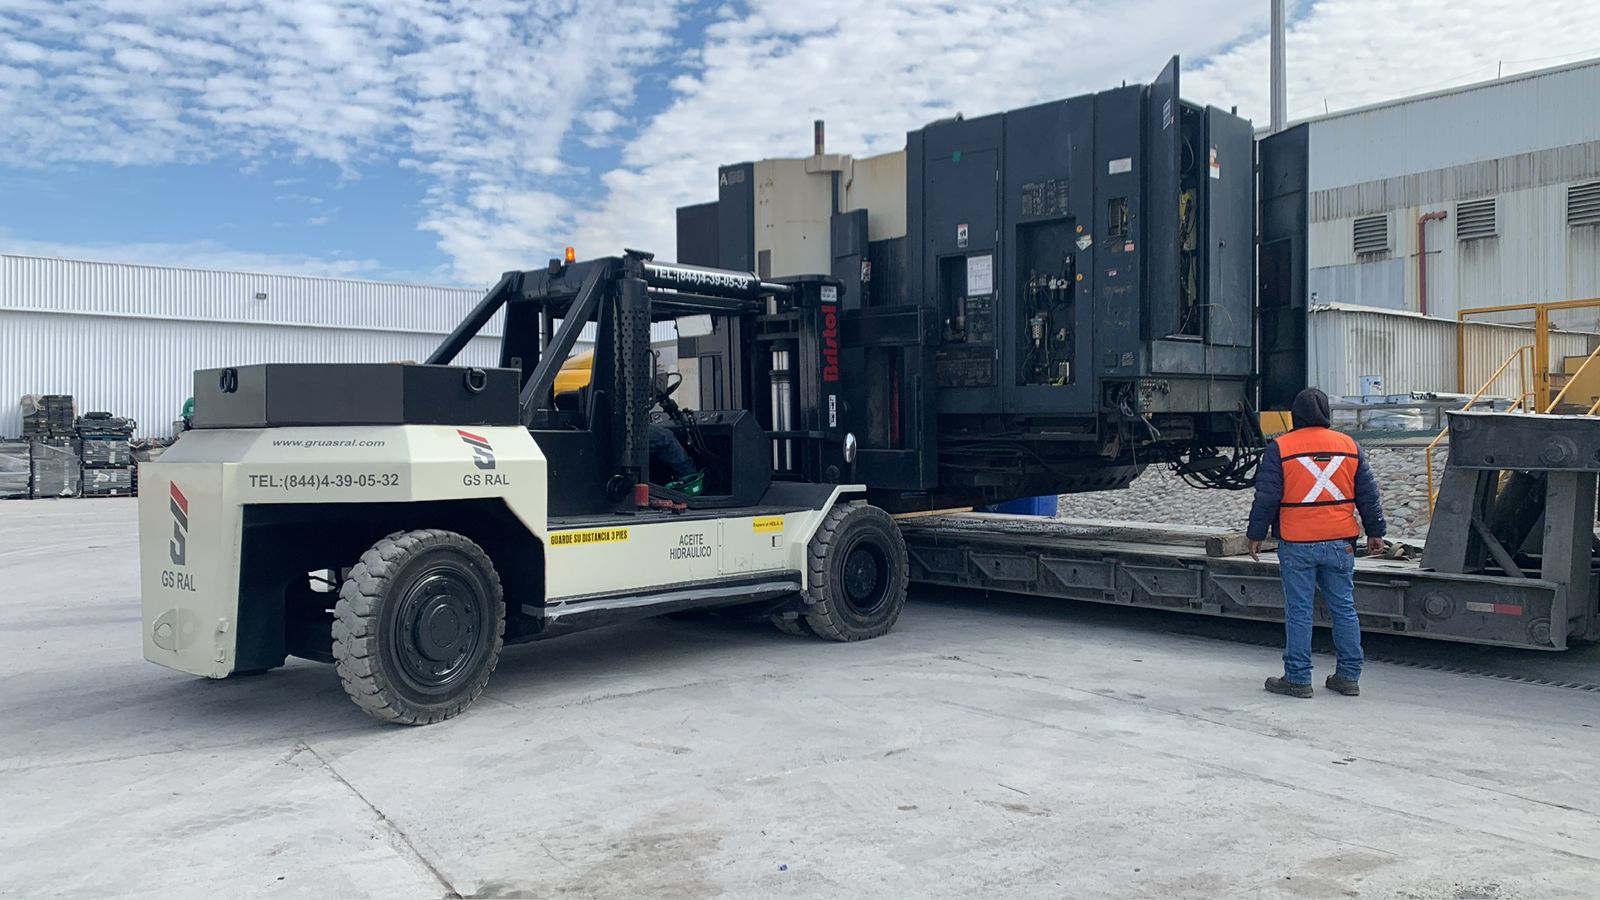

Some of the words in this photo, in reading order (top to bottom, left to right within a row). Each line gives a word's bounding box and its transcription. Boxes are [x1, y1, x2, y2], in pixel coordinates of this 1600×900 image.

[654, 266, 749, 290] TEL:(844)4-39-05-32
[821, 305, 839, 382] Bristol
[272, 439, 385, 448] www.gruasral.com
[249, 473, 399, 490] TEL:(844)4-39-05-32
[463, 474, 481, 486] GS
[485, 474, 510, 486] RAL
[550, 534, 573, 545] GUARDE
[573, 533, 582, 543] SU
[582, 531, 610, 543] DISTANCIA
[611, 531, 615, 540] 3
[616, 530, 628, 540] PIES
[679, 533, 704, 546] ACEITE
[670, 545, 712, 560] HIDRAULICO
[161, 570, 175, 589] GS
[177, 572, 196, 592] RAL
